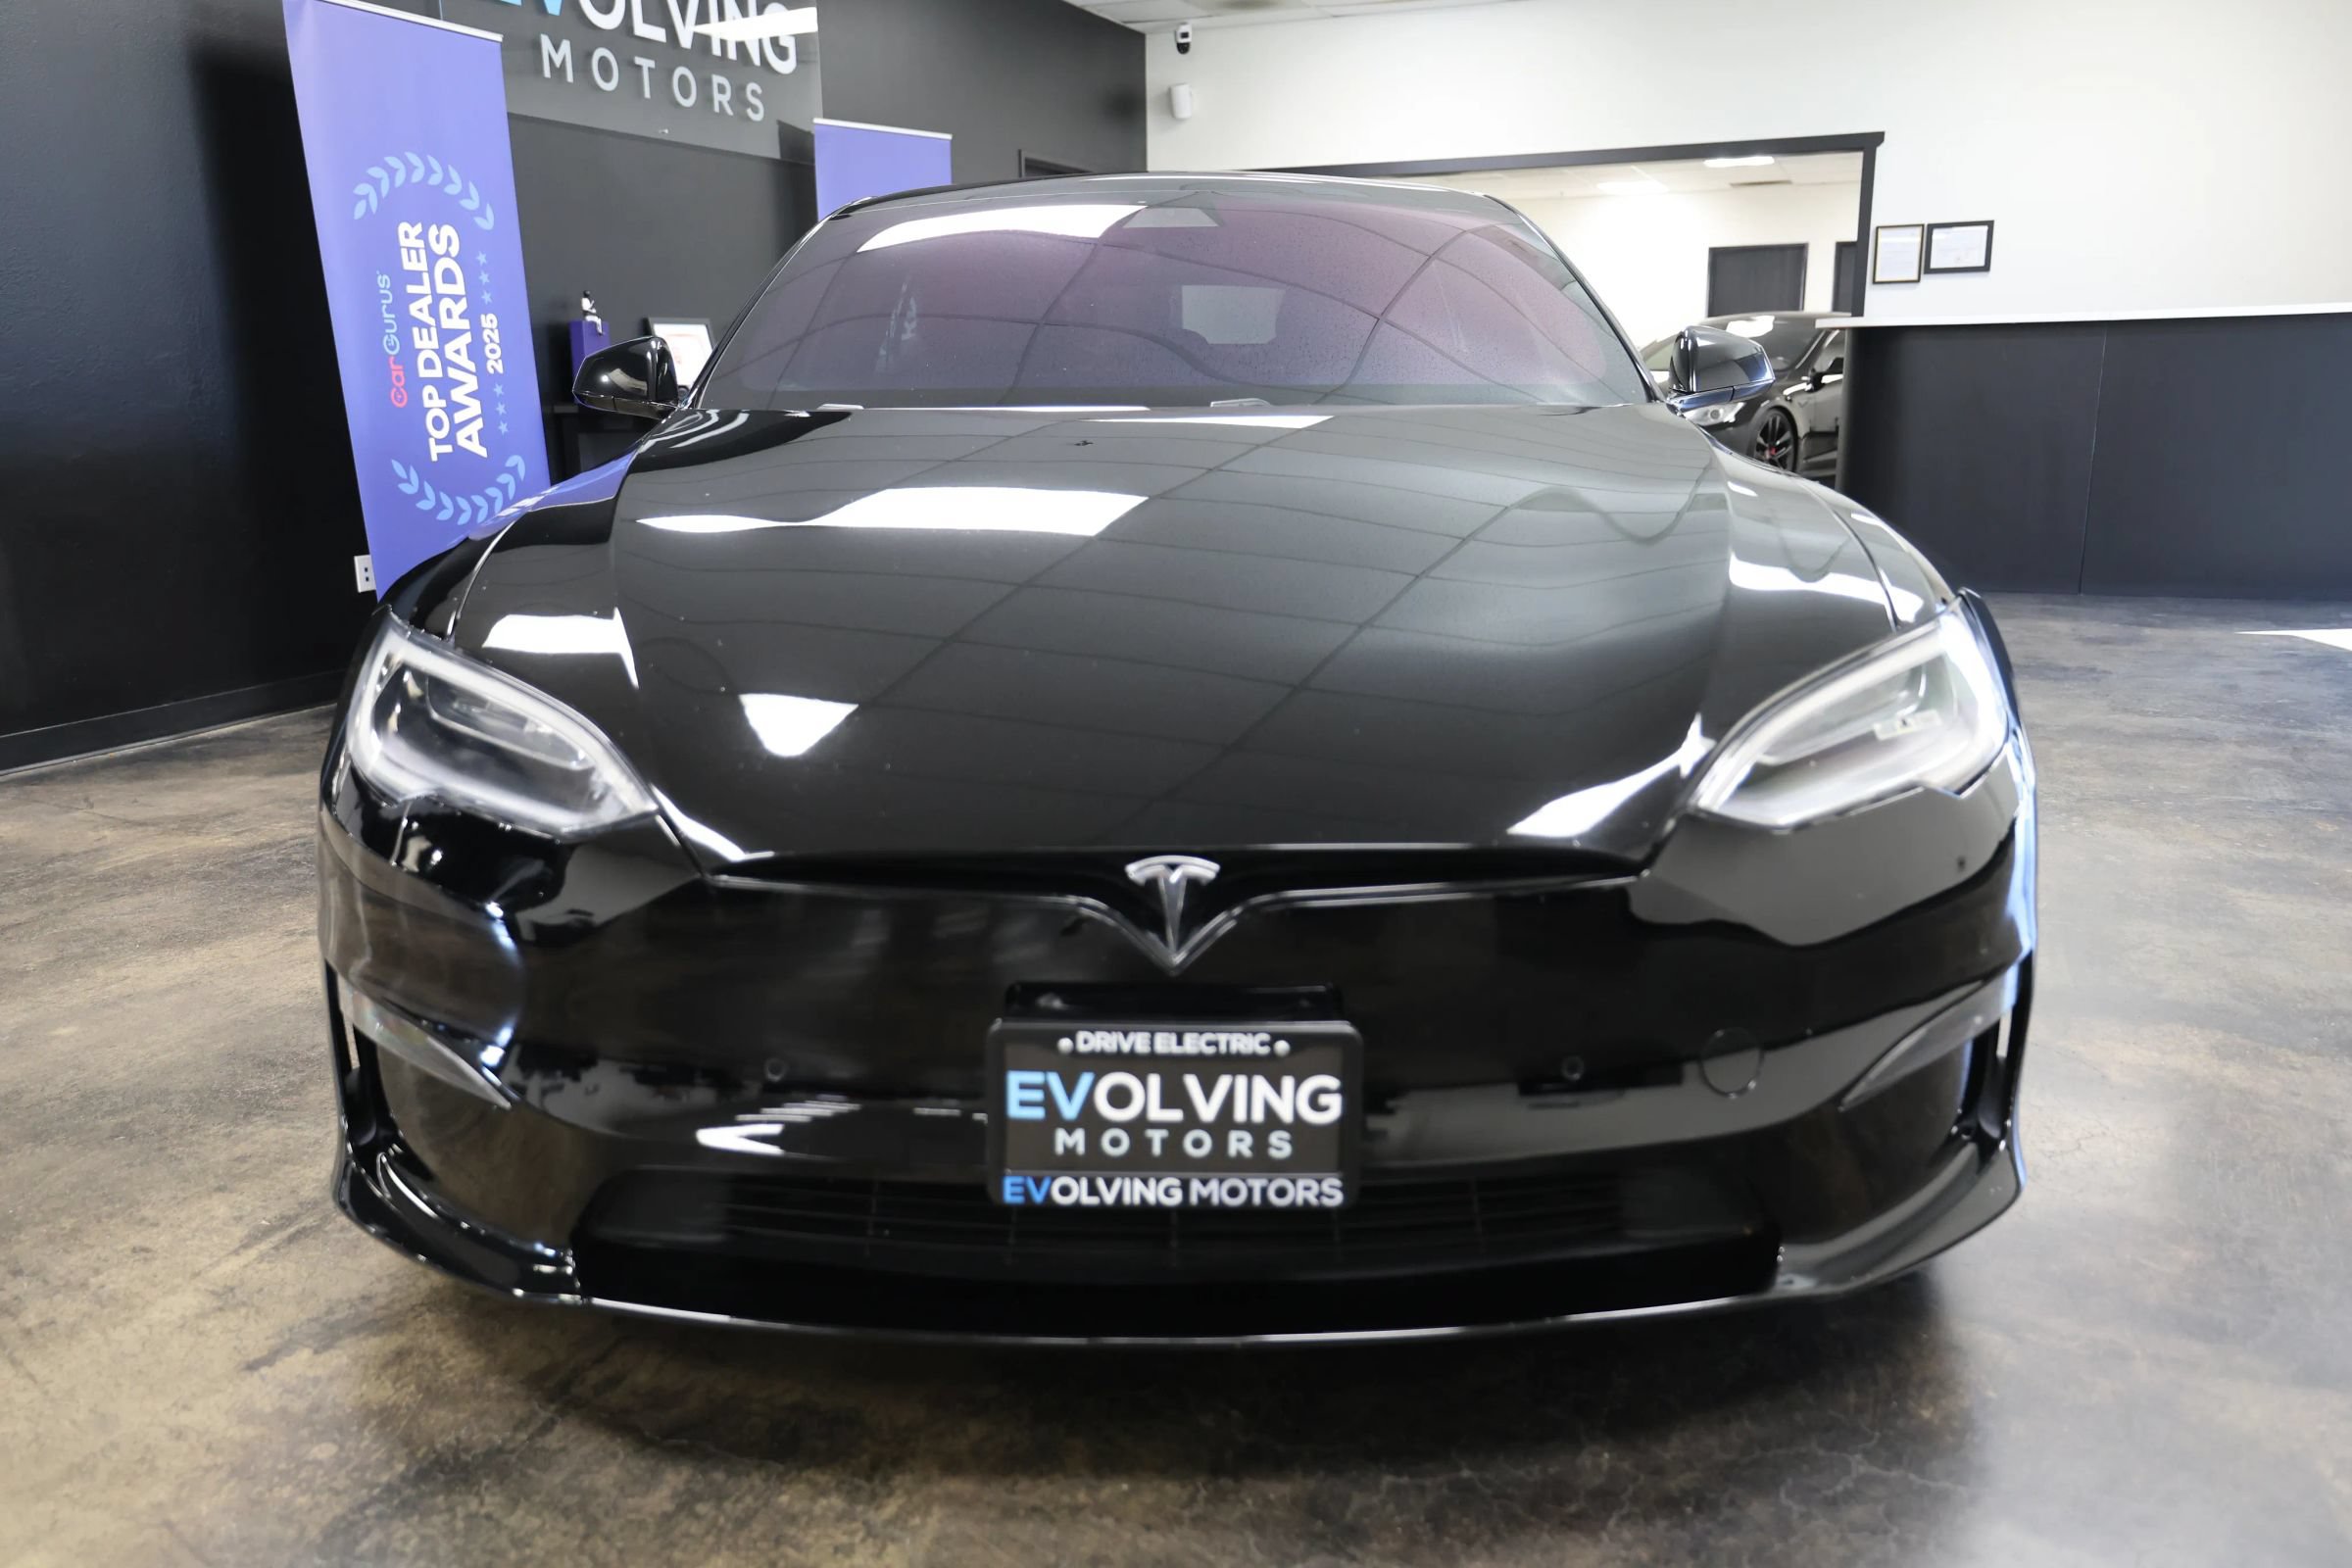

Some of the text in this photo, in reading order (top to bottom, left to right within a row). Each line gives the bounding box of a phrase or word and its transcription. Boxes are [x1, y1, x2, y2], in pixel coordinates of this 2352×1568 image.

[540, 33, 765, 122] MOTORS
[376, 274, 408, 408] CarGurus
[397, 221, 454, 463] TOP DEALER
[427, 223, 488, 459] AWARDS
[480, 313, 504, 374] 2025
[1075, 1030, 1271, 1056] DRIVE ELECTRIC
[1005, 1070, 1344, 1126] EVOLVING
[1054, 1127, 1294, 1159] MOTORS
[1003, 1175, 1345, 1207] EVOLVING MOTORS
